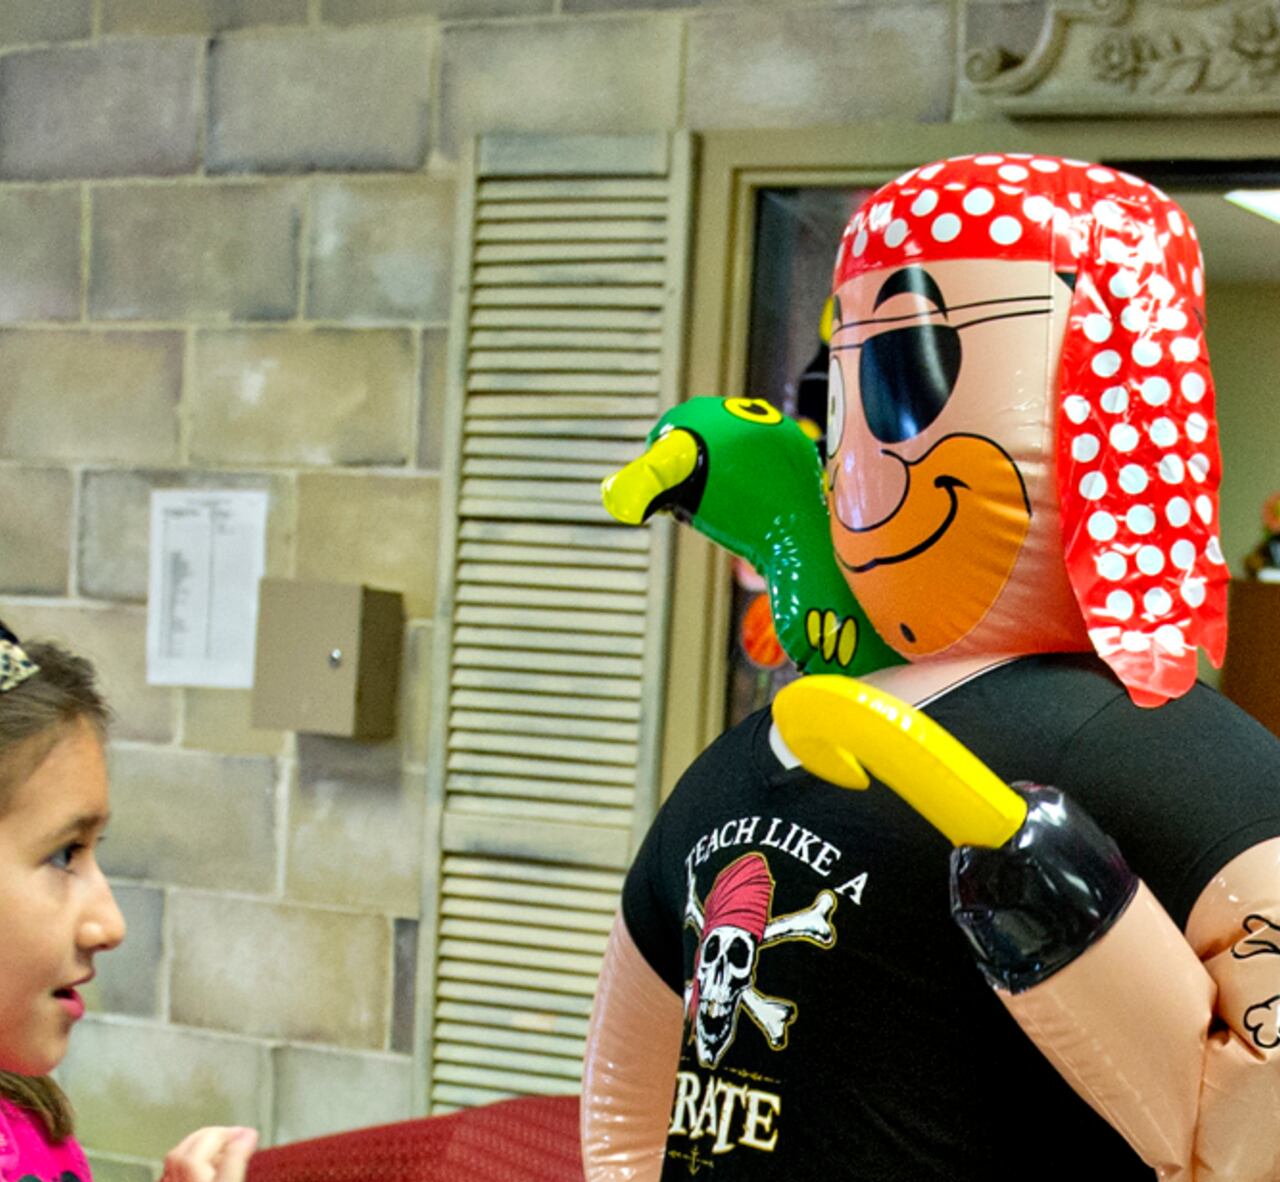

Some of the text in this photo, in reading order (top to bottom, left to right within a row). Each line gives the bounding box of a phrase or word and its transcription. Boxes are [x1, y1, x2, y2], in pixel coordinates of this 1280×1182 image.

[685, 816, 869, 906] TEACH LIKE A
[667, 1071, 782, 1155] RATE
